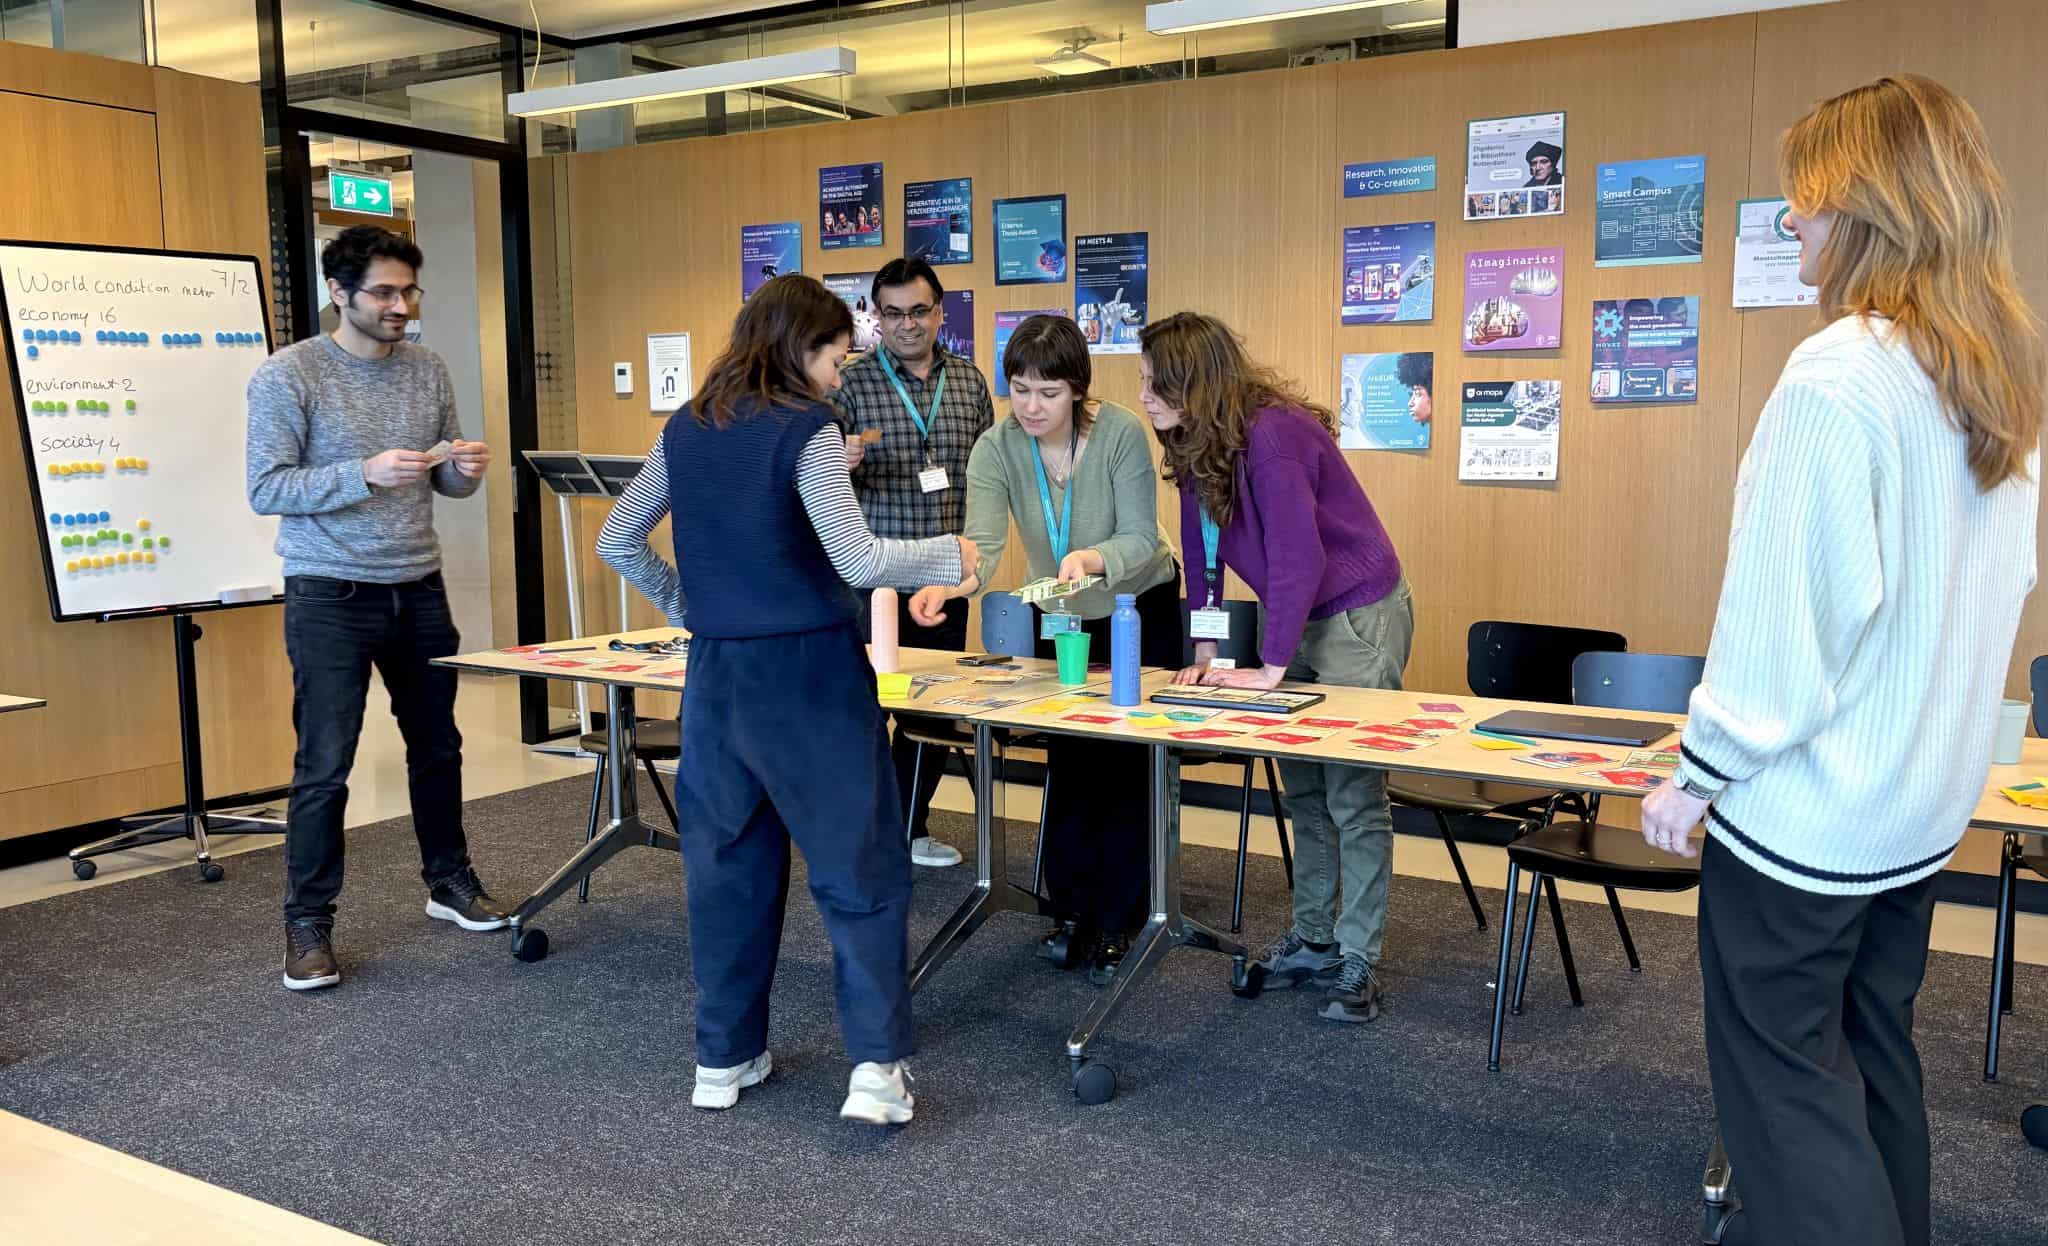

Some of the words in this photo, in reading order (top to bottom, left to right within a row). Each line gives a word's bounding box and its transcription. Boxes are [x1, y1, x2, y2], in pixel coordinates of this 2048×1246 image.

[1345, 167, 1386, 180] Research,
[1388, 163, 1434, 176] Innovation
[1359, 182, 1366, 190] &
[1368, 177, 1420, 190] Co-creation
[1602, 190, 1631, 200] Smart
[1632, 187, 1673, 198] Campus
[1470, 255, 1556, 269] AImaginaries
[18, 267, 88, 293] World
[94, 275, 170, 295] condition
[18, 307, 89, 328] economy
[99, 307, 118, 324] 16
[26, 378, 118, 394] environment
[122, 378, 137, 393] 2
[108, 437, 121, 452] 4
